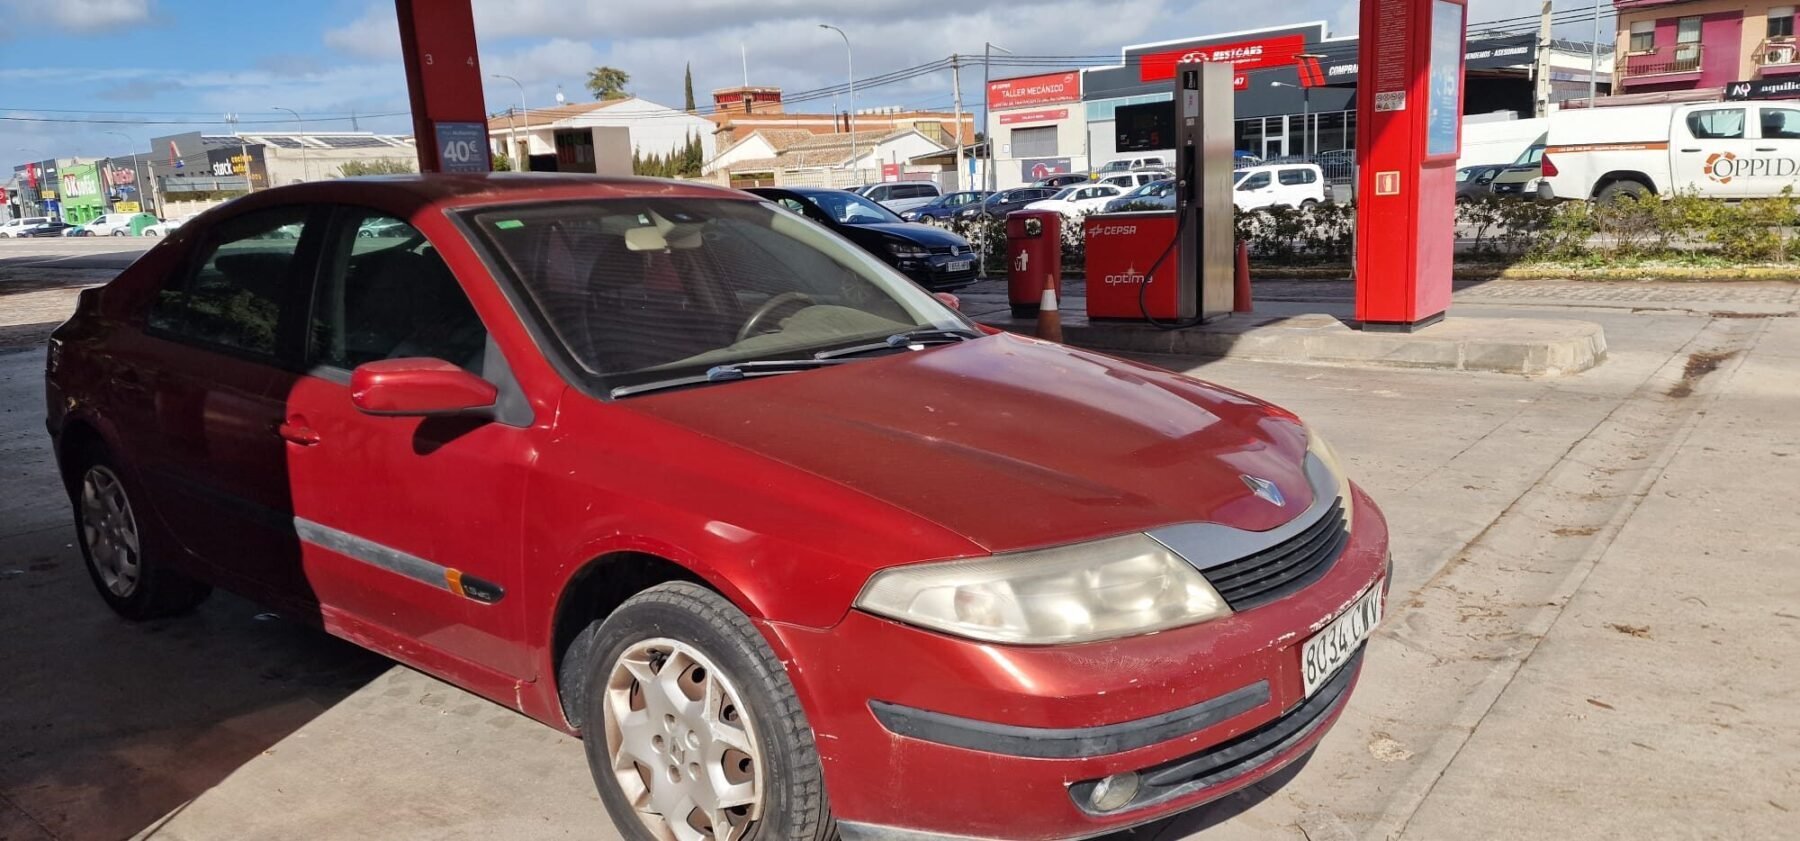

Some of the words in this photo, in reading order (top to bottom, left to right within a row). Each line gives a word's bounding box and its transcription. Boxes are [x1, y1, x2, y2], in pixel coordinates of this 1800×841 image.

[425, 54, 433, 65] 3
[467, 56, 474, 68] 4
[1001, 89, 1026, 98] TALLER
[1027, 83, 1064, 95] MECÁNICO
[1104, 225, 1137, 235] CEPSA
[1306, 619, 1347, 685] 8034
